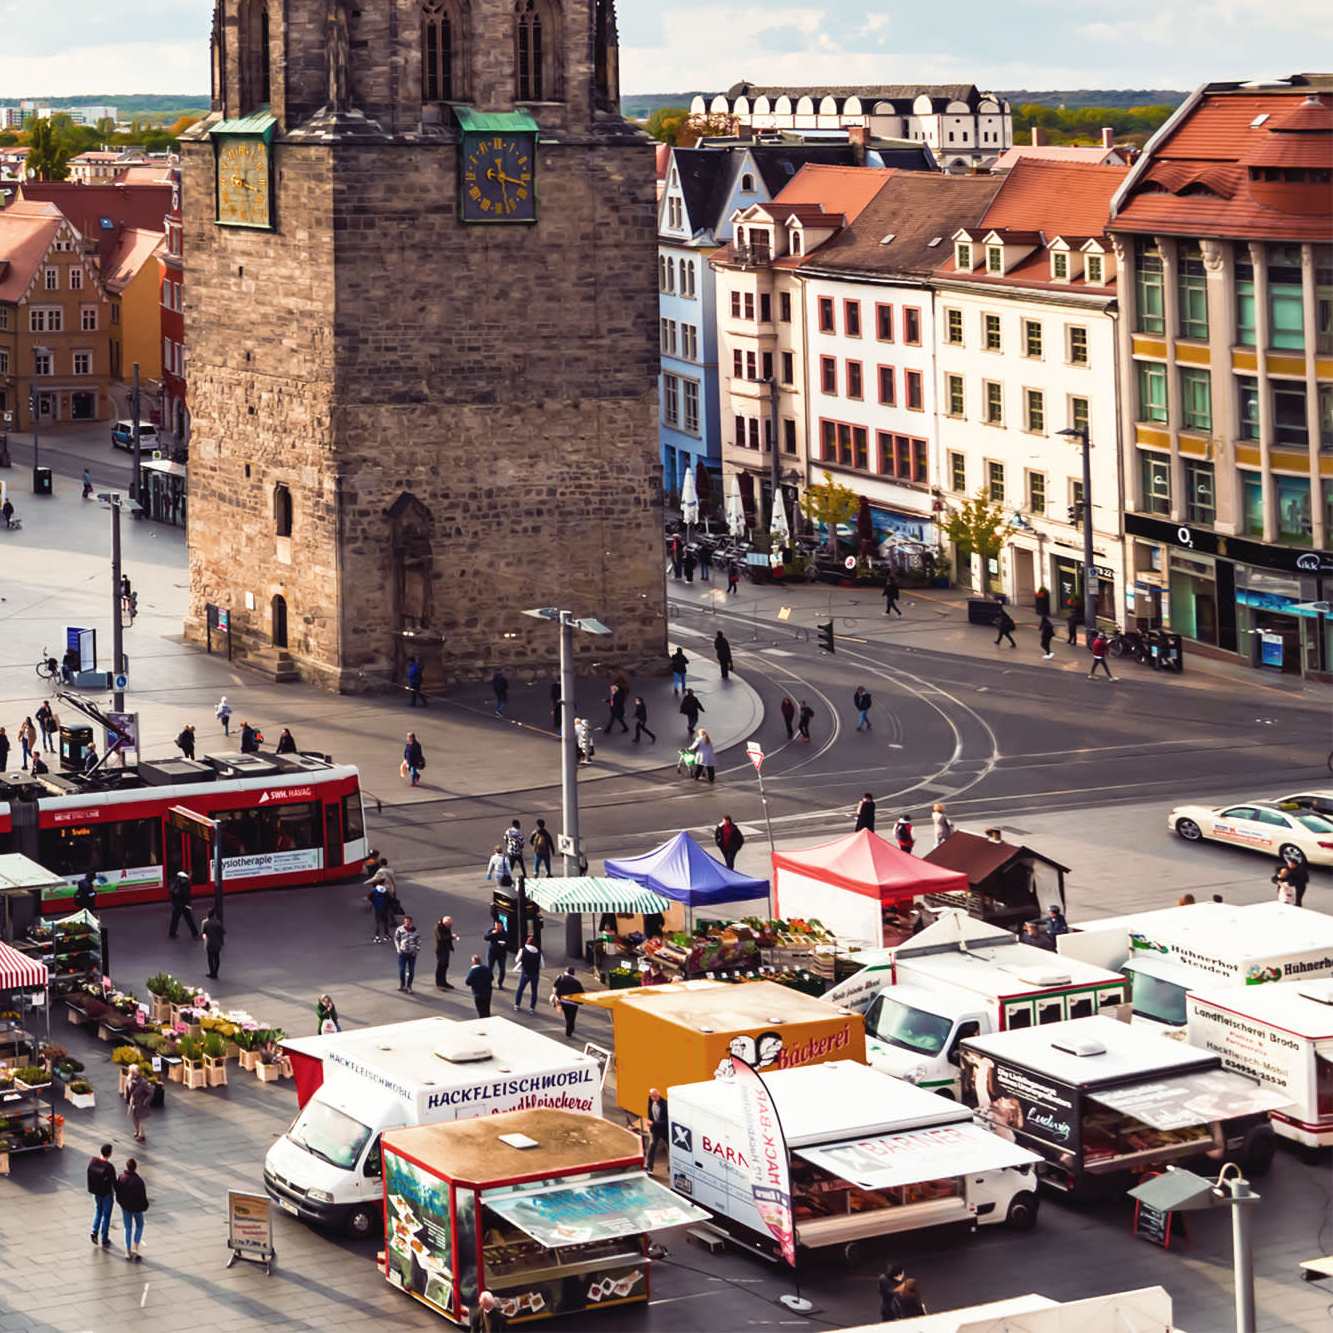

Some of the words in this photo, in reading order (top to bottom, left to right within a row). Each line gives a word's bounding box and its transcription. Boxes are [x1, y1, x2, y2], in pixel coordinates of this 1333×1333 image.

[287, 786, 312, 798] HAVAG
[777, 1024, 851, 1070] Bäckerei
[1193, 1004, 1267, 1040] Landfleischerei
[1269, 1032, 1301, 1052] Broda
[327, 1050, 413, 1101] HACKFLEISCHMOBIL
[1205, 1040, 1289, 1078] Hackfleisch-Mobil
[427, 1068, 594, 1110] HACKFLEISCHMOBIL
[1026, 1106, 1071, 1142] Ludwig
